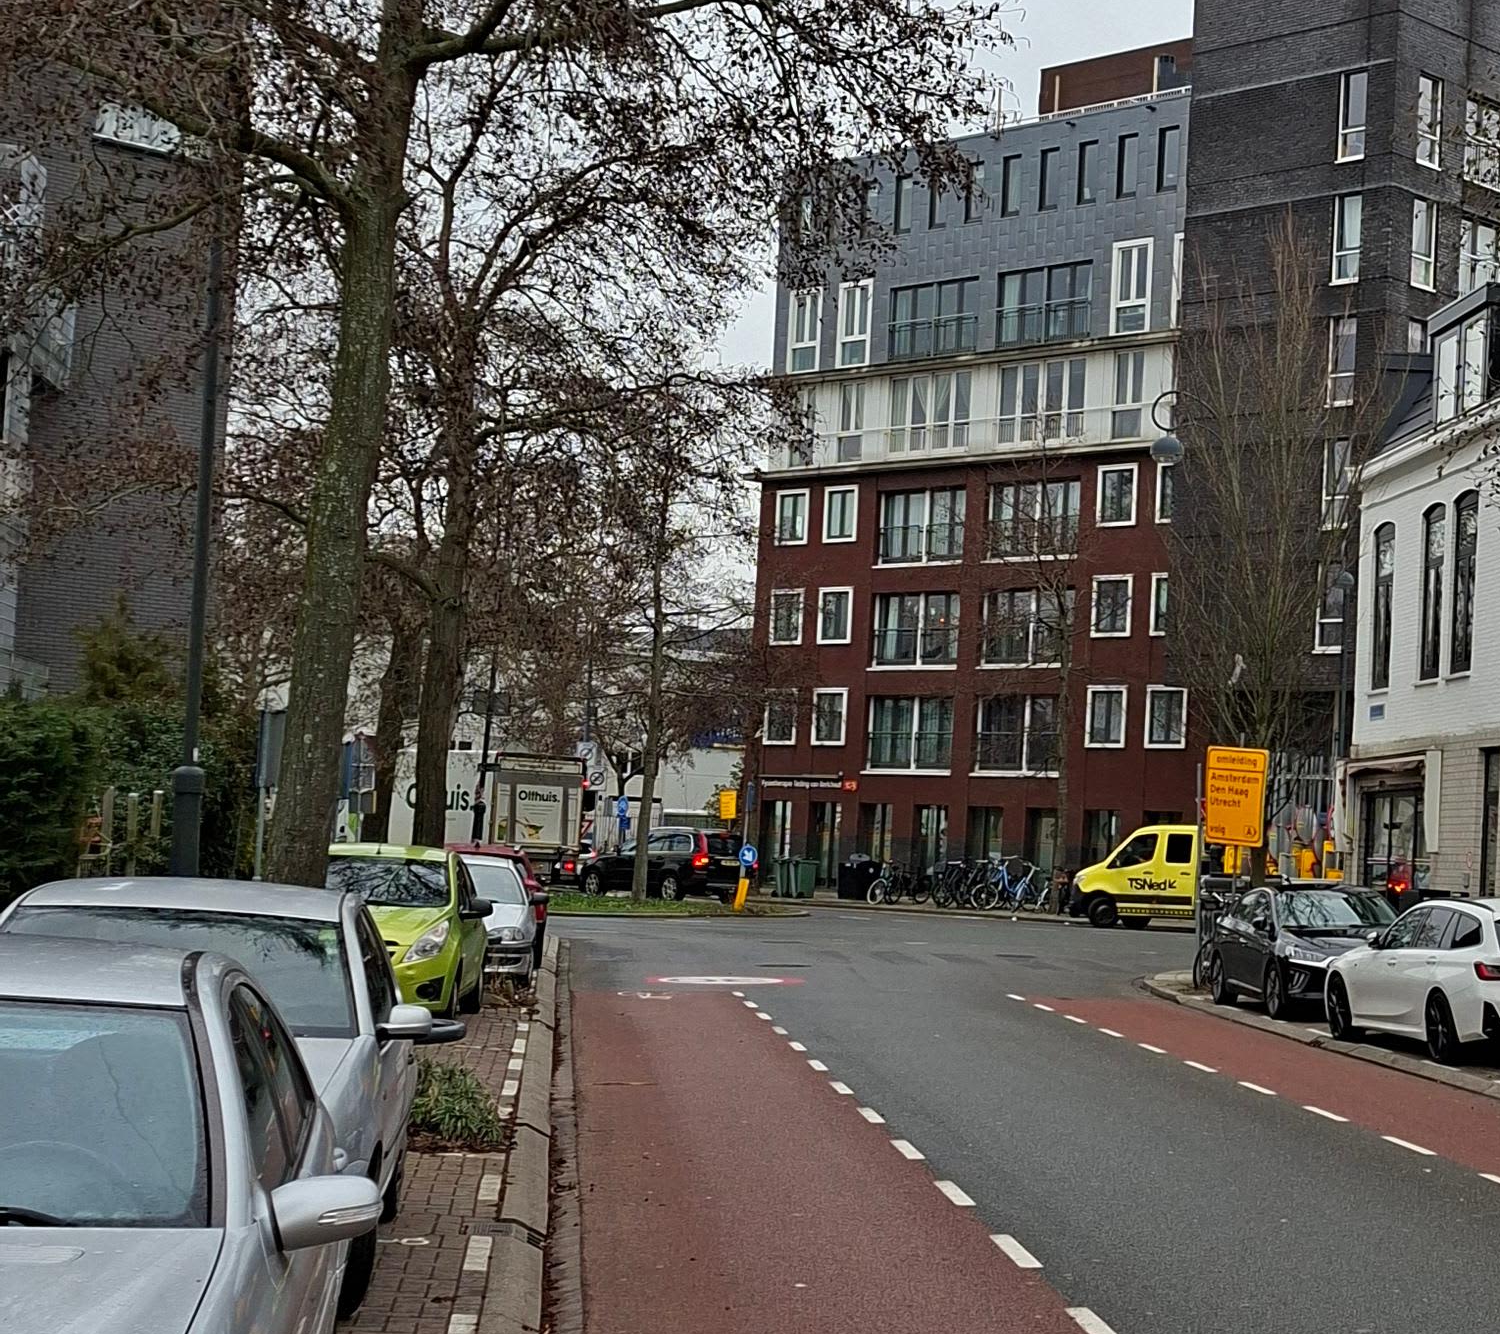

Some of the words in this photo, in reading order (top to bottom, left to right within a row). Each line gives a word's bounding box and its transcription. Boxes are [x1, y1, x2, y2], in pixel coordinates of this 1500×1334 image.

[1216, 755, 1257, 767] omleiding
[1210, 772, 1260, 784] Amsterdam
[1210, 784, 1226, 794] Den
[1227, 786, 1249, 798] Haag
[1210, 796, 1241, 807] Utrecht
[1210, 826, 1226, 836] volg
[1127, 877, 1167, 891] TSNed
